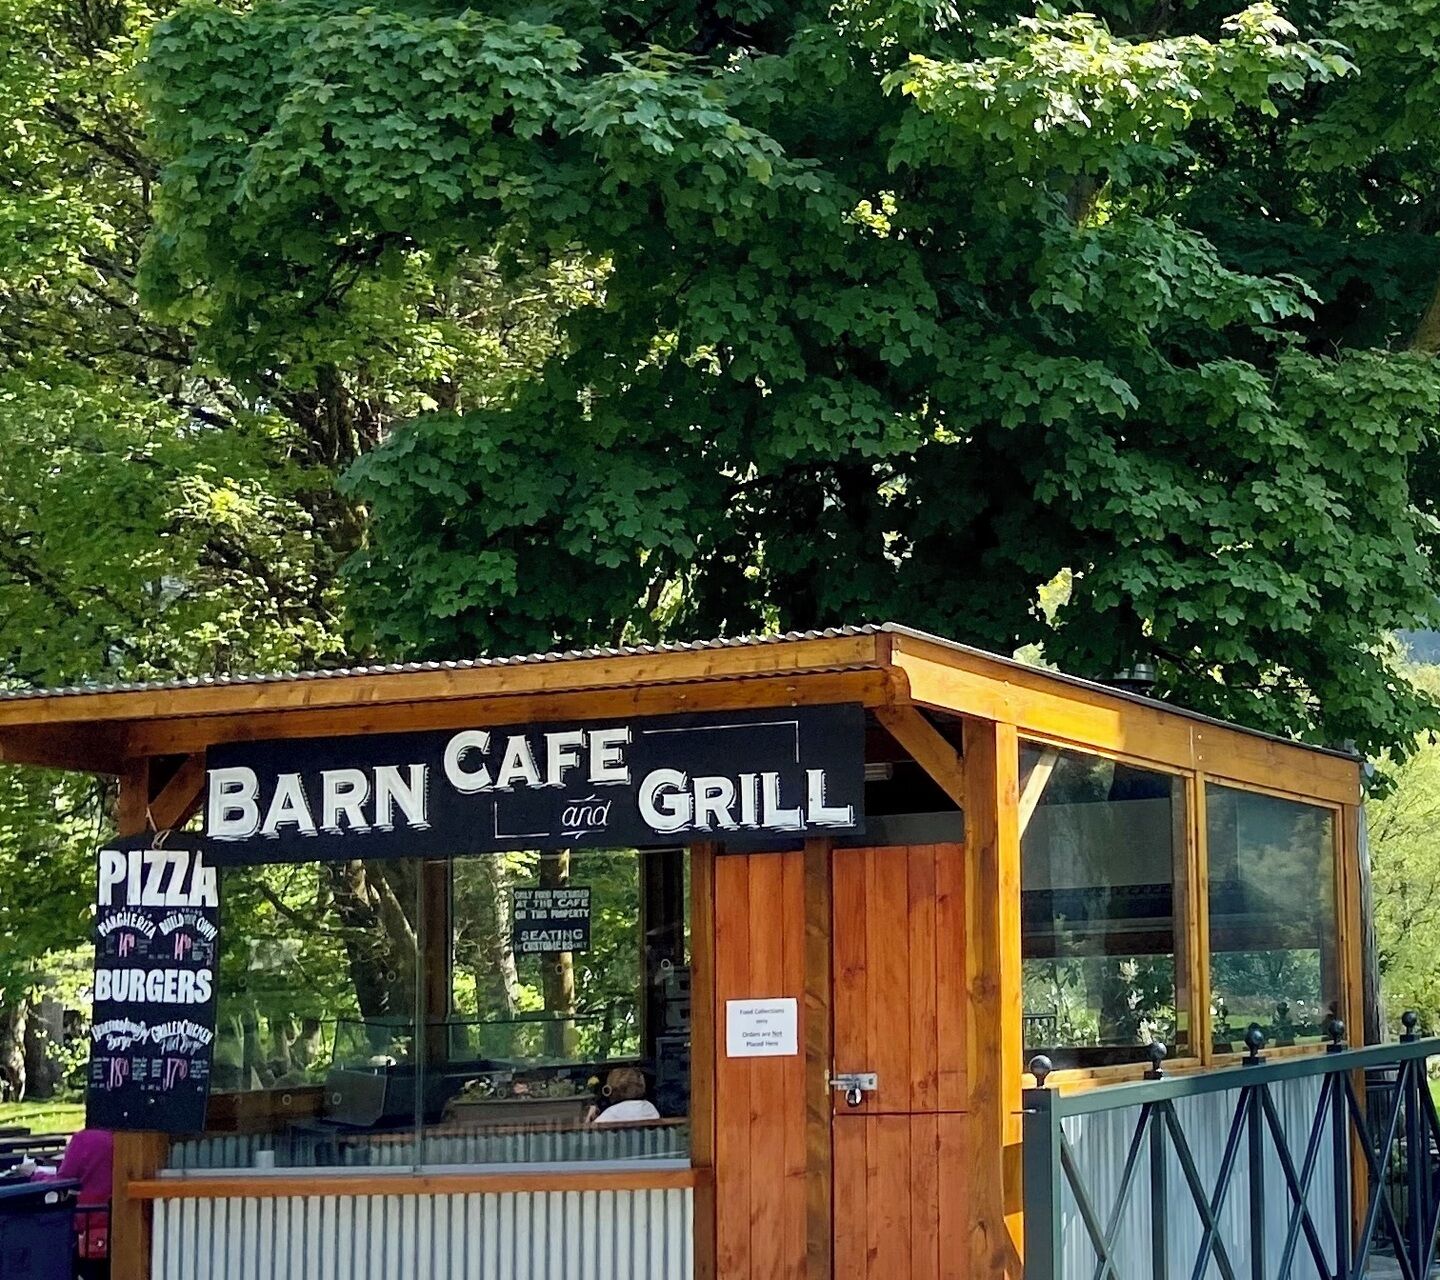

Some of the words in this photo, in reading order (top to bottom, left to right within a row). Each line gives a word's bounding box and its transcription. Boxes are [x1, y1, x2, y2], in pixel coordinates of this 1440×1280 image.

[207, 764, 431, 841] BARN
[444, 726, 633, 794] CAFE
[562, 800, 611, 827] and
[639, 769, 856, 833] GRILL
[98, 850, 218, 907] PIZZA
[516, 900, 527, 908] AT
[558, 899, 588, 907] CAFE
[98, 911, 156, 940] MARGHERITA
[521, 929, 583, 941] SEATING
[95, 969, 212, 1003] BURGERS
